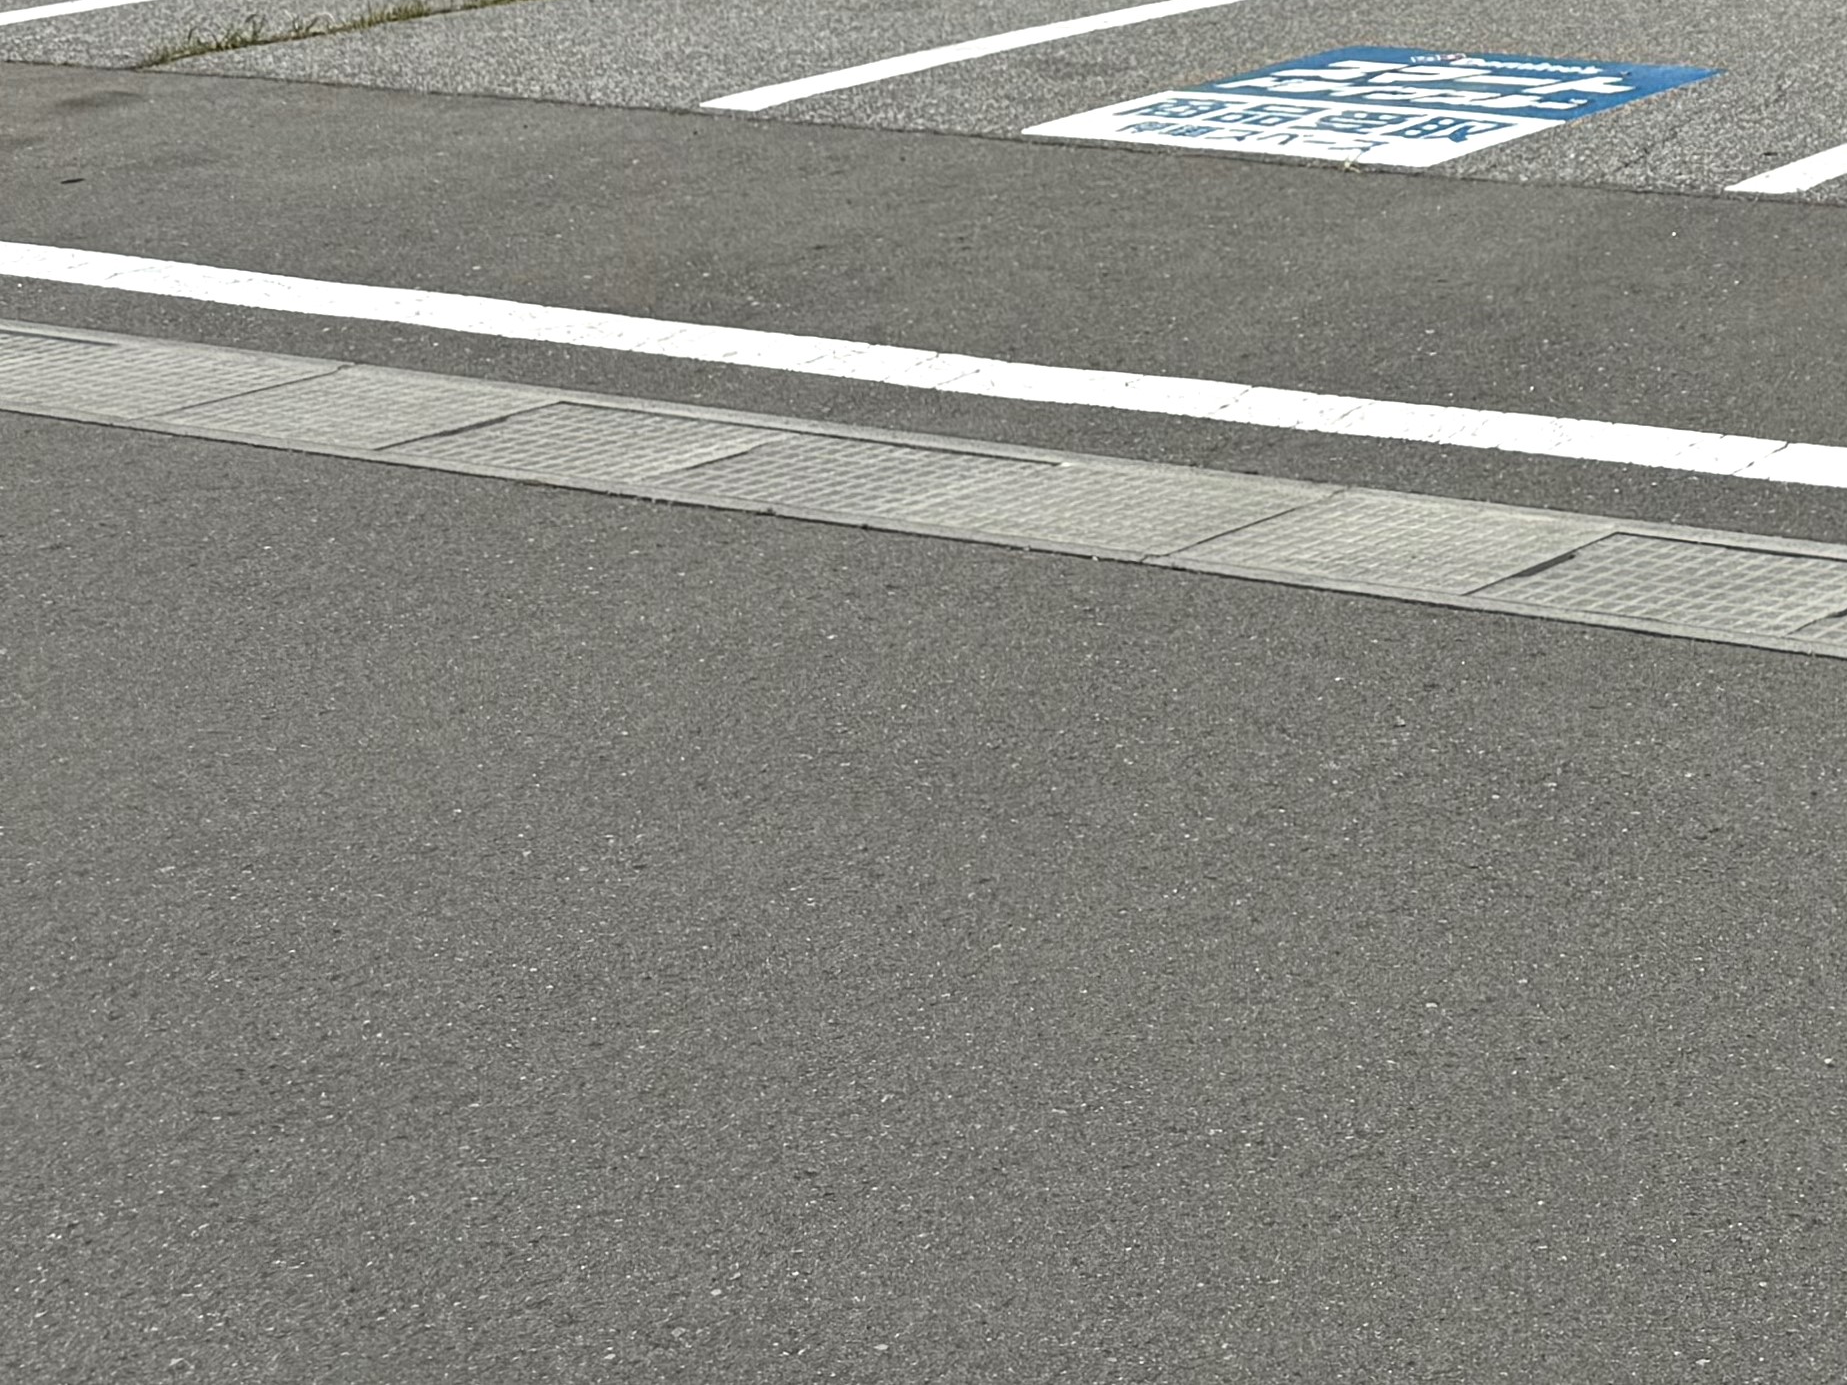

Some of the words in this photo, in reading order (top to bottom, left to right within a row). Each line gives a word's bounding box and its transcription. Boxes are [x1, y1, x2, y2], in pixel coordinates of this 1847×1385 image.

[1272, 60, 1636, 94] スマート
[1113, 98, 1518, 143] 商品受取
